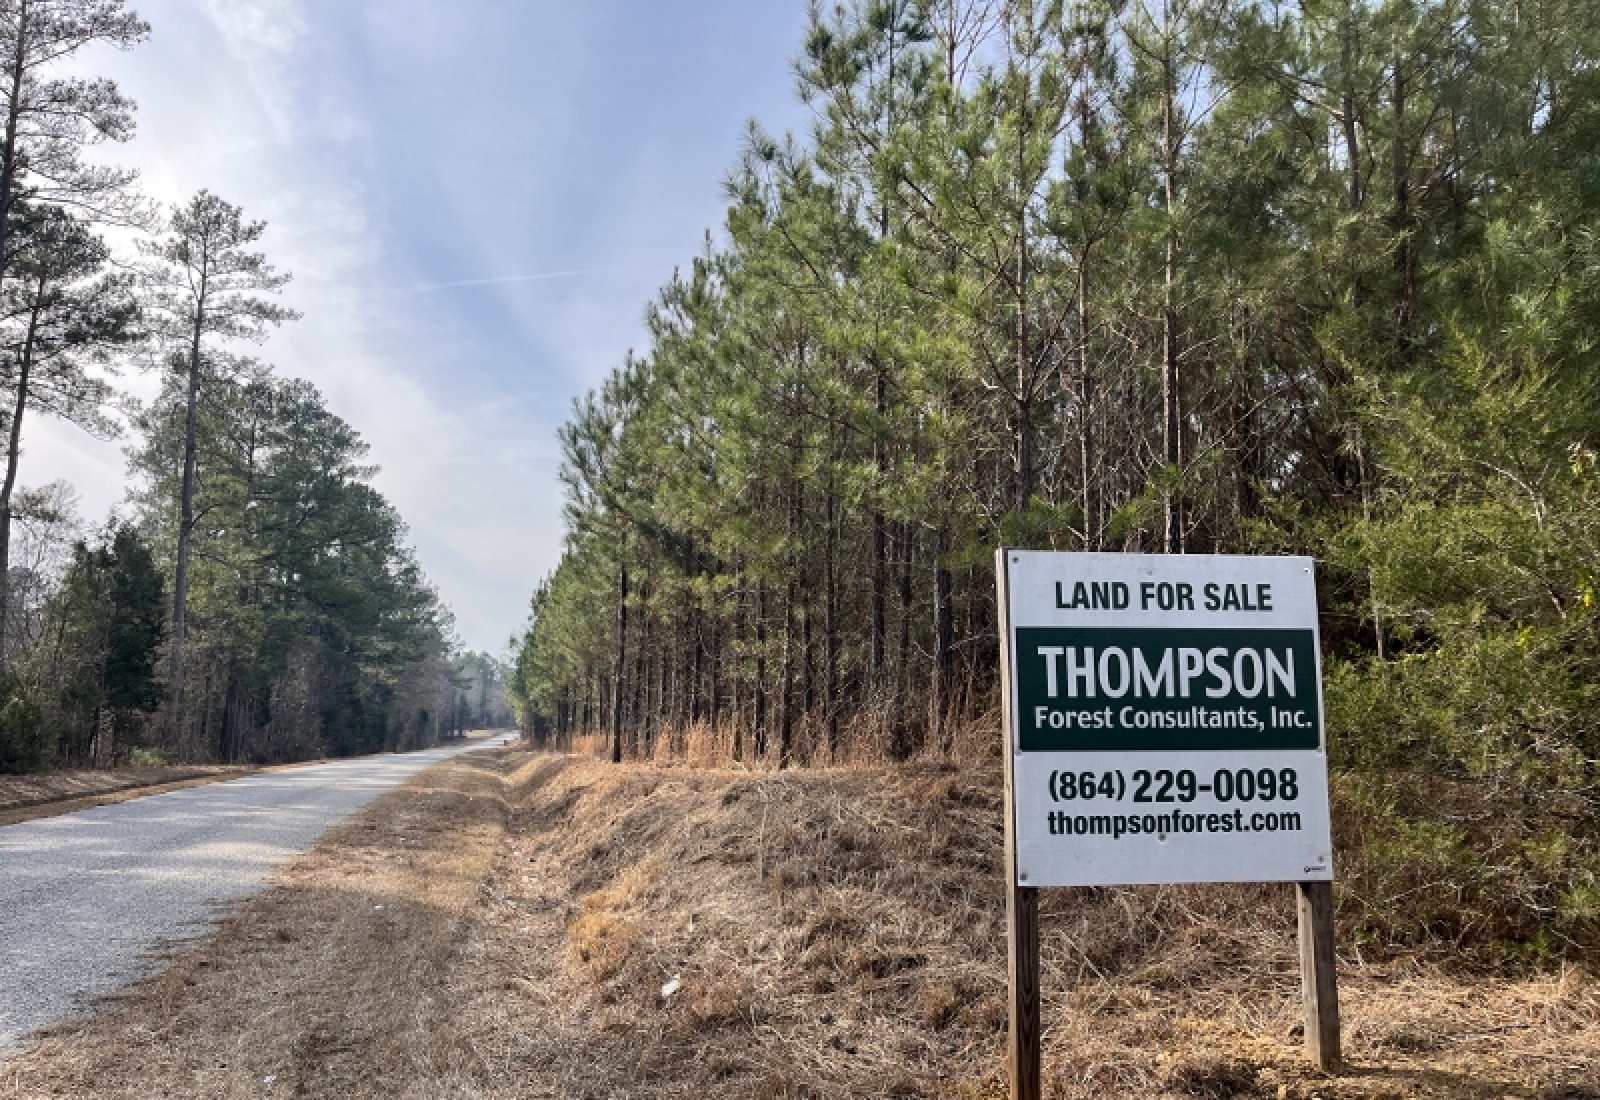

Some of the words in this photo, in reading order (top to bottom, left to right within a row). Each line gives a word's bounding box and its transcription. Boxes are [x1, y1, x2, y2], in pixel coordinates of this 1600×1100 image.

[1055, 581, 1130, 610] LAND
[1140, 582, 1195, 611] FOR
[1204, 583, 1273, 611] SALE
[1037, 645, 1297, 699] THOMPSON
[1034, 705, 1113, 729] Forest
[1119, 705, 1265, 732] Consultants,
[1271, 706, 1313, 729] Inc.
[1048, 769, 1126, 802] (864)
[1132, 767, 1299, 803] 229-0098
[1048, 809, 1302, 840] thompsonforest.com
